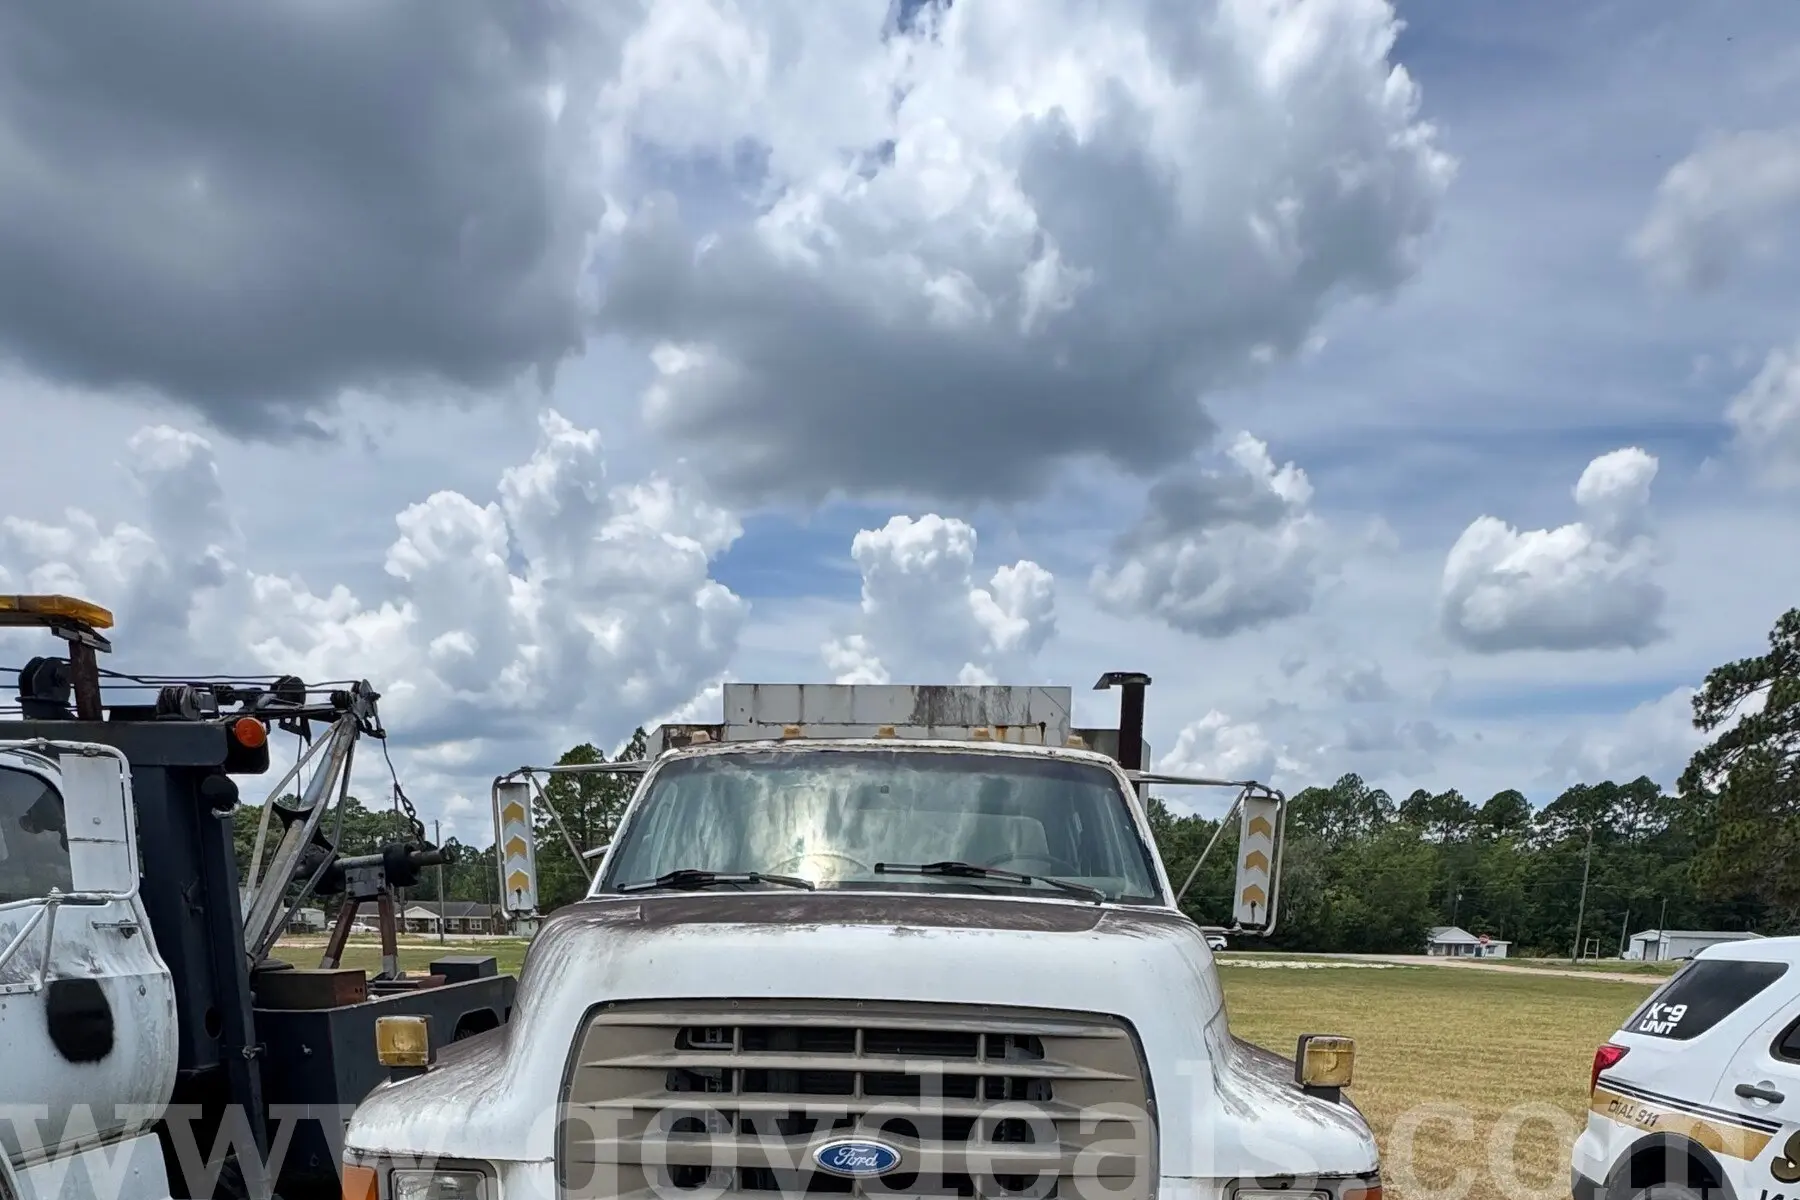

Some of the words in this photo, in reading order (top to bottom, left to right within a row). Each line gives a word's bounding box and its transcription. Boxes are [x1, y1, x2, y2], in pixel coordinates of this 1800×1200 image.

[1646, 1002, 1687, 1021] K-9
[1640, 1020, 1677, 1034] UNIT
[1608, 1099, 1634, 1118] DIAL
[1635, 1109, 1660, 1127] 911
[833, 1147, 879, 1167] Ford
